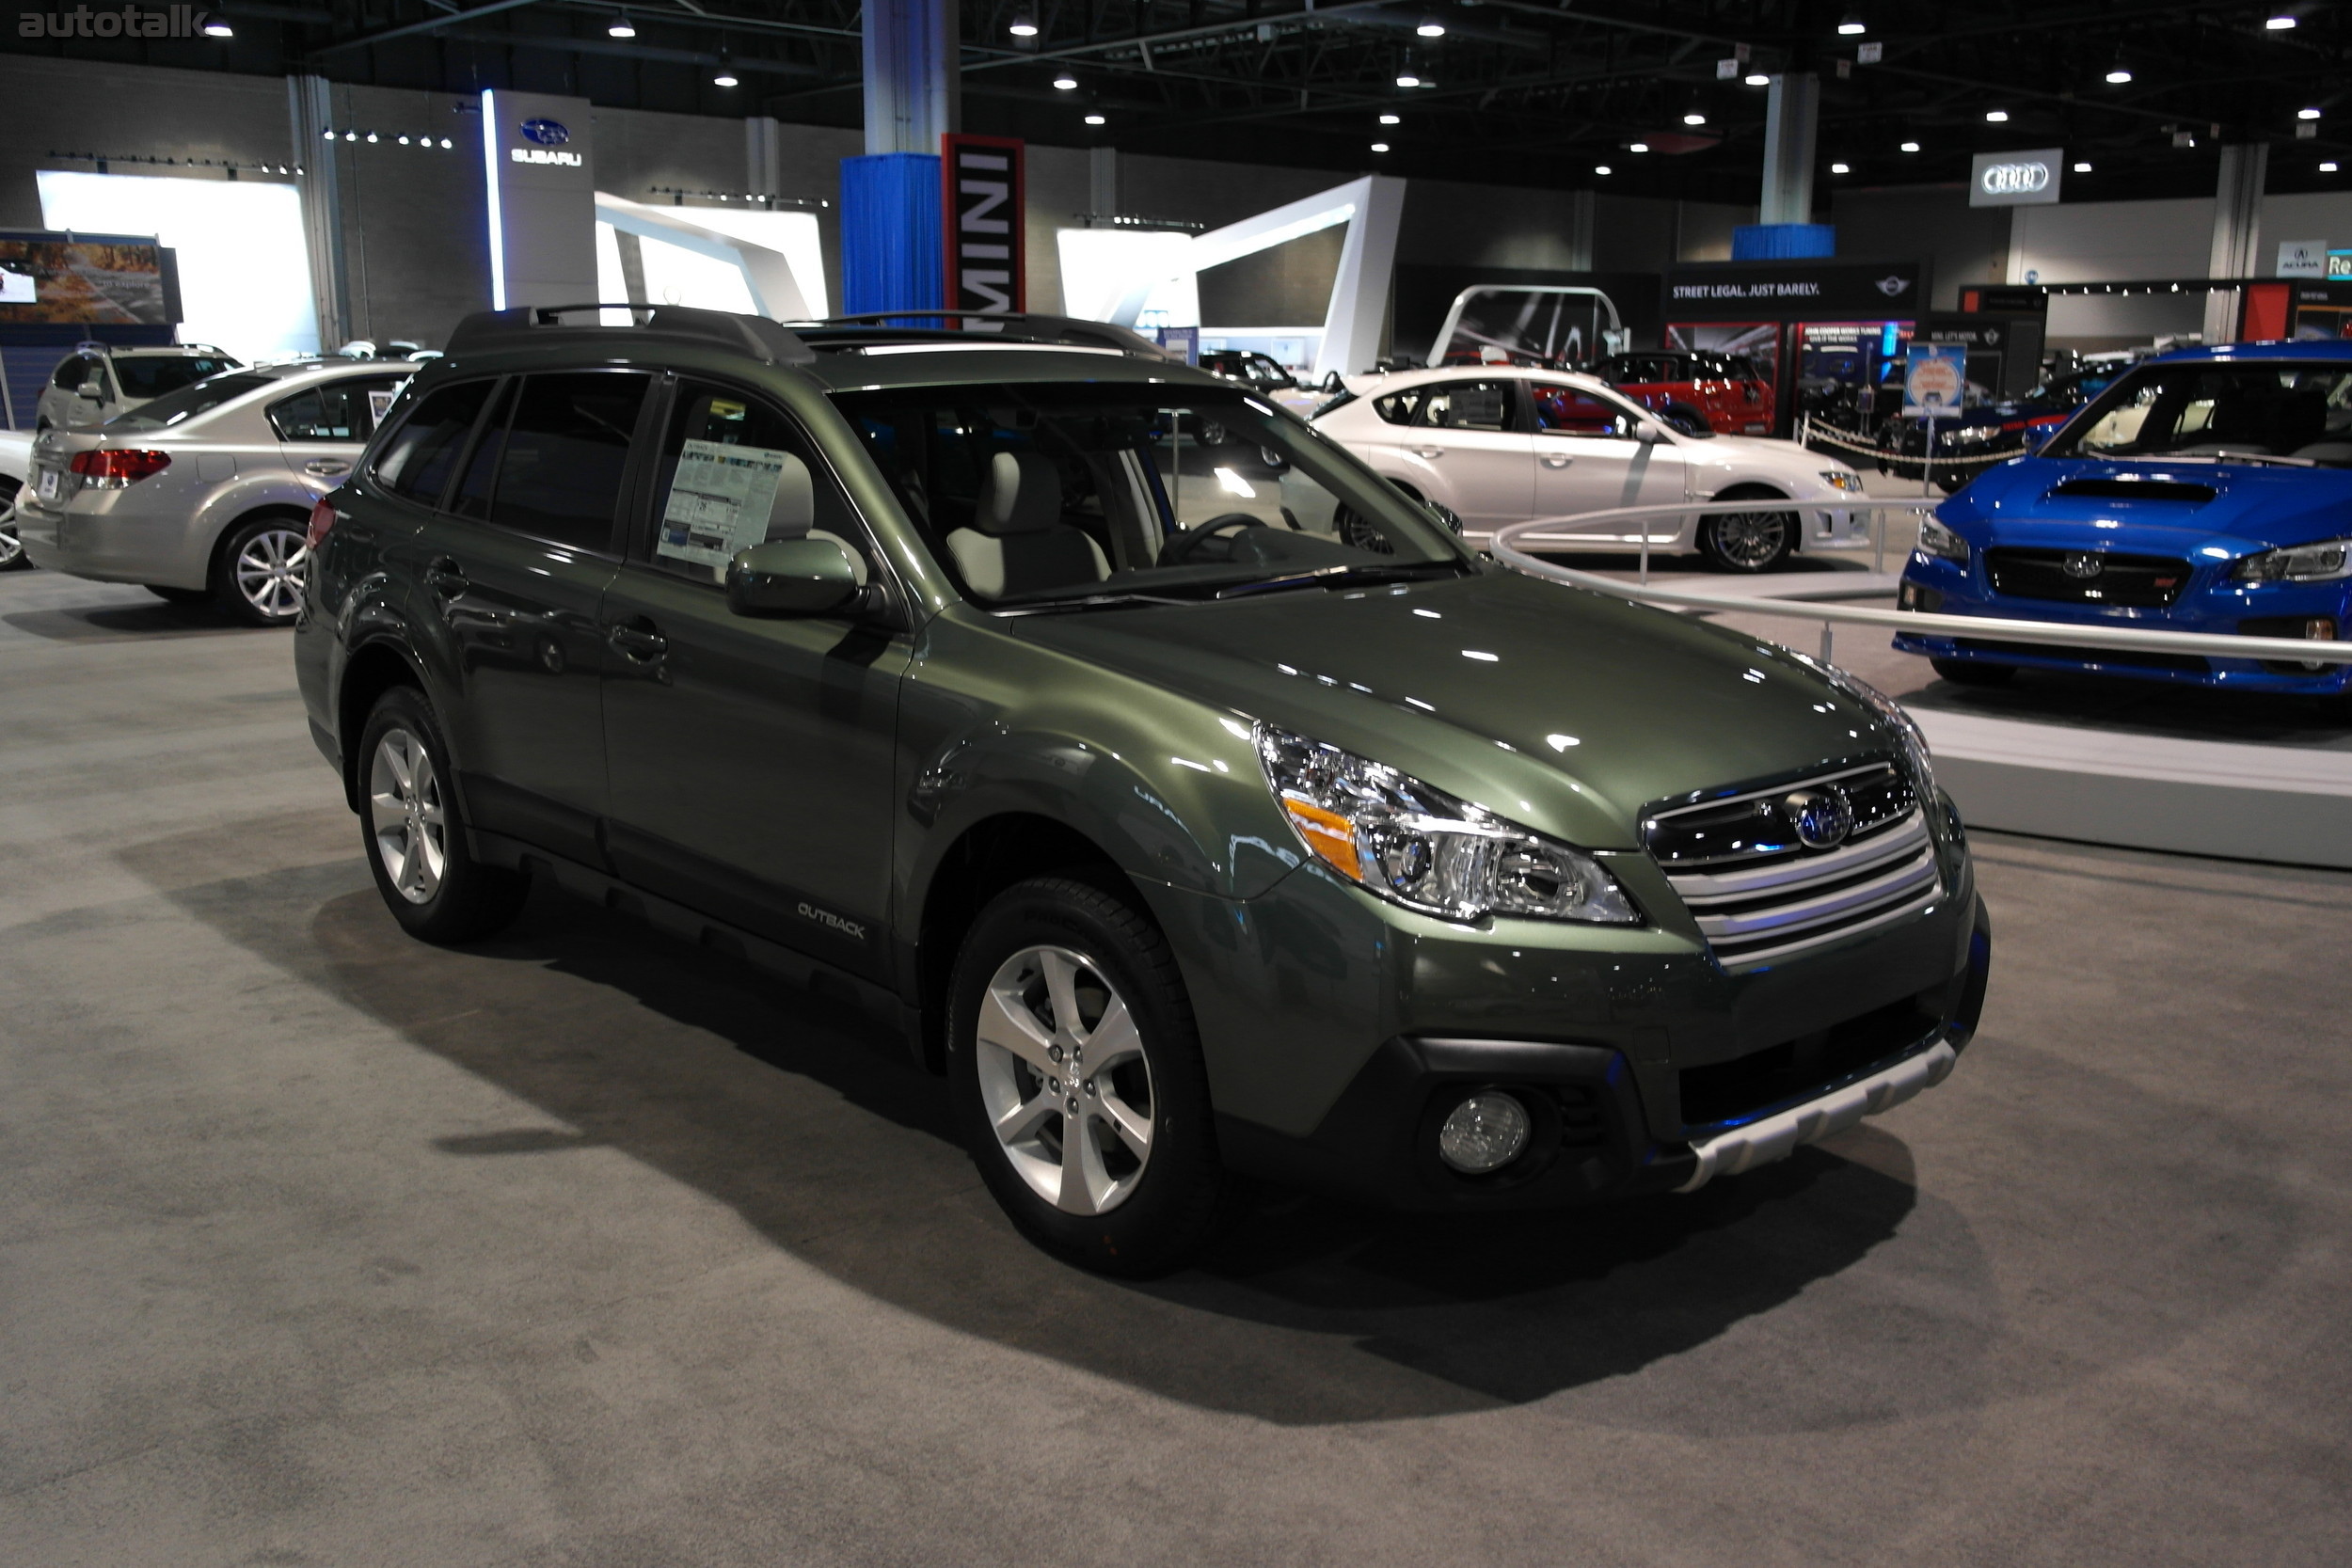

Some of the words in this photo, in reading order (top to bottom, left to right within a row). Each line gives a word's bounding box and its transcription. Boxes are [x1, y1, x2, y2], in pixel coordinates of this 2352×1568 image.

[511, 148, 583, 167] SUBARU
[960, 151, 1011, 331] MINI
[1673, 285, 1708, 298] STREET
[1710, 284, 1746, 298] LEGAL.
[1748, 284, 1775, 296] JUST
[1777, 282, 1820, 296] BARELY.
[798, 902, 866, 940] OUTBACK
